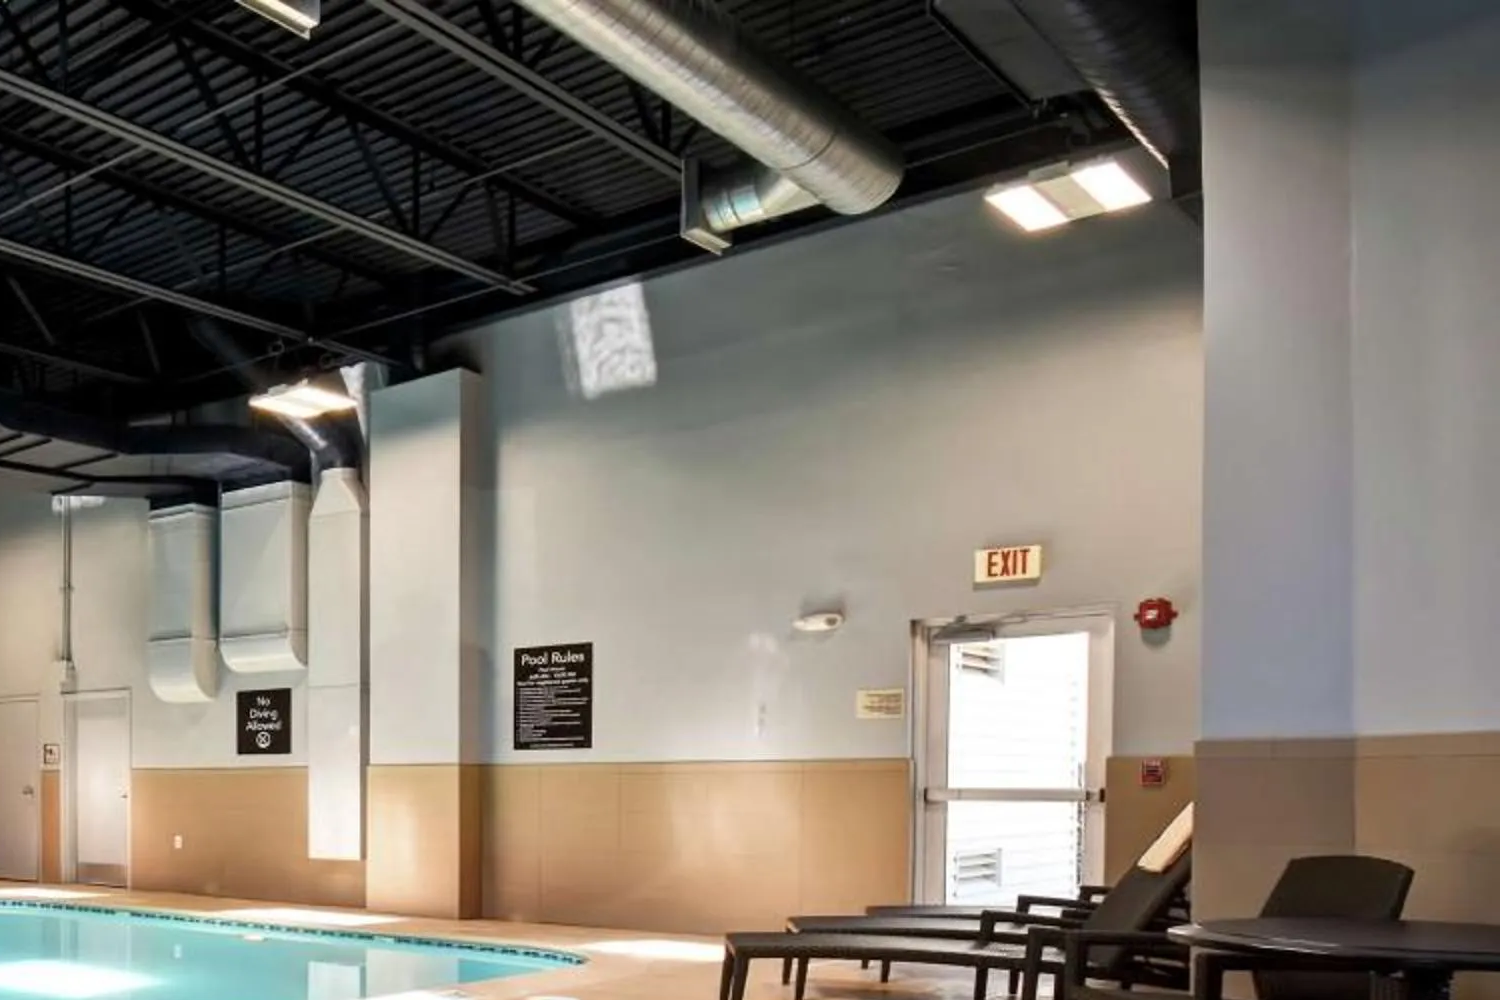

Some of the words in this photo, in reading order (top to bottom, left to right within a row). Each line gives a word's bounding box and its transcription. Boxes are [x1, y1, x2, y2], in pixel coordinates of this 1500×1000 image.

[987, 548, 1031, 577] EXIT
[521, 651, 549, 666] Pool
[551, 650, 585, 664] Rules
[256, 696, 271, 706] No
[249, 708, 279, 720] Diving
[245, 720, 282, 731] Allowed
